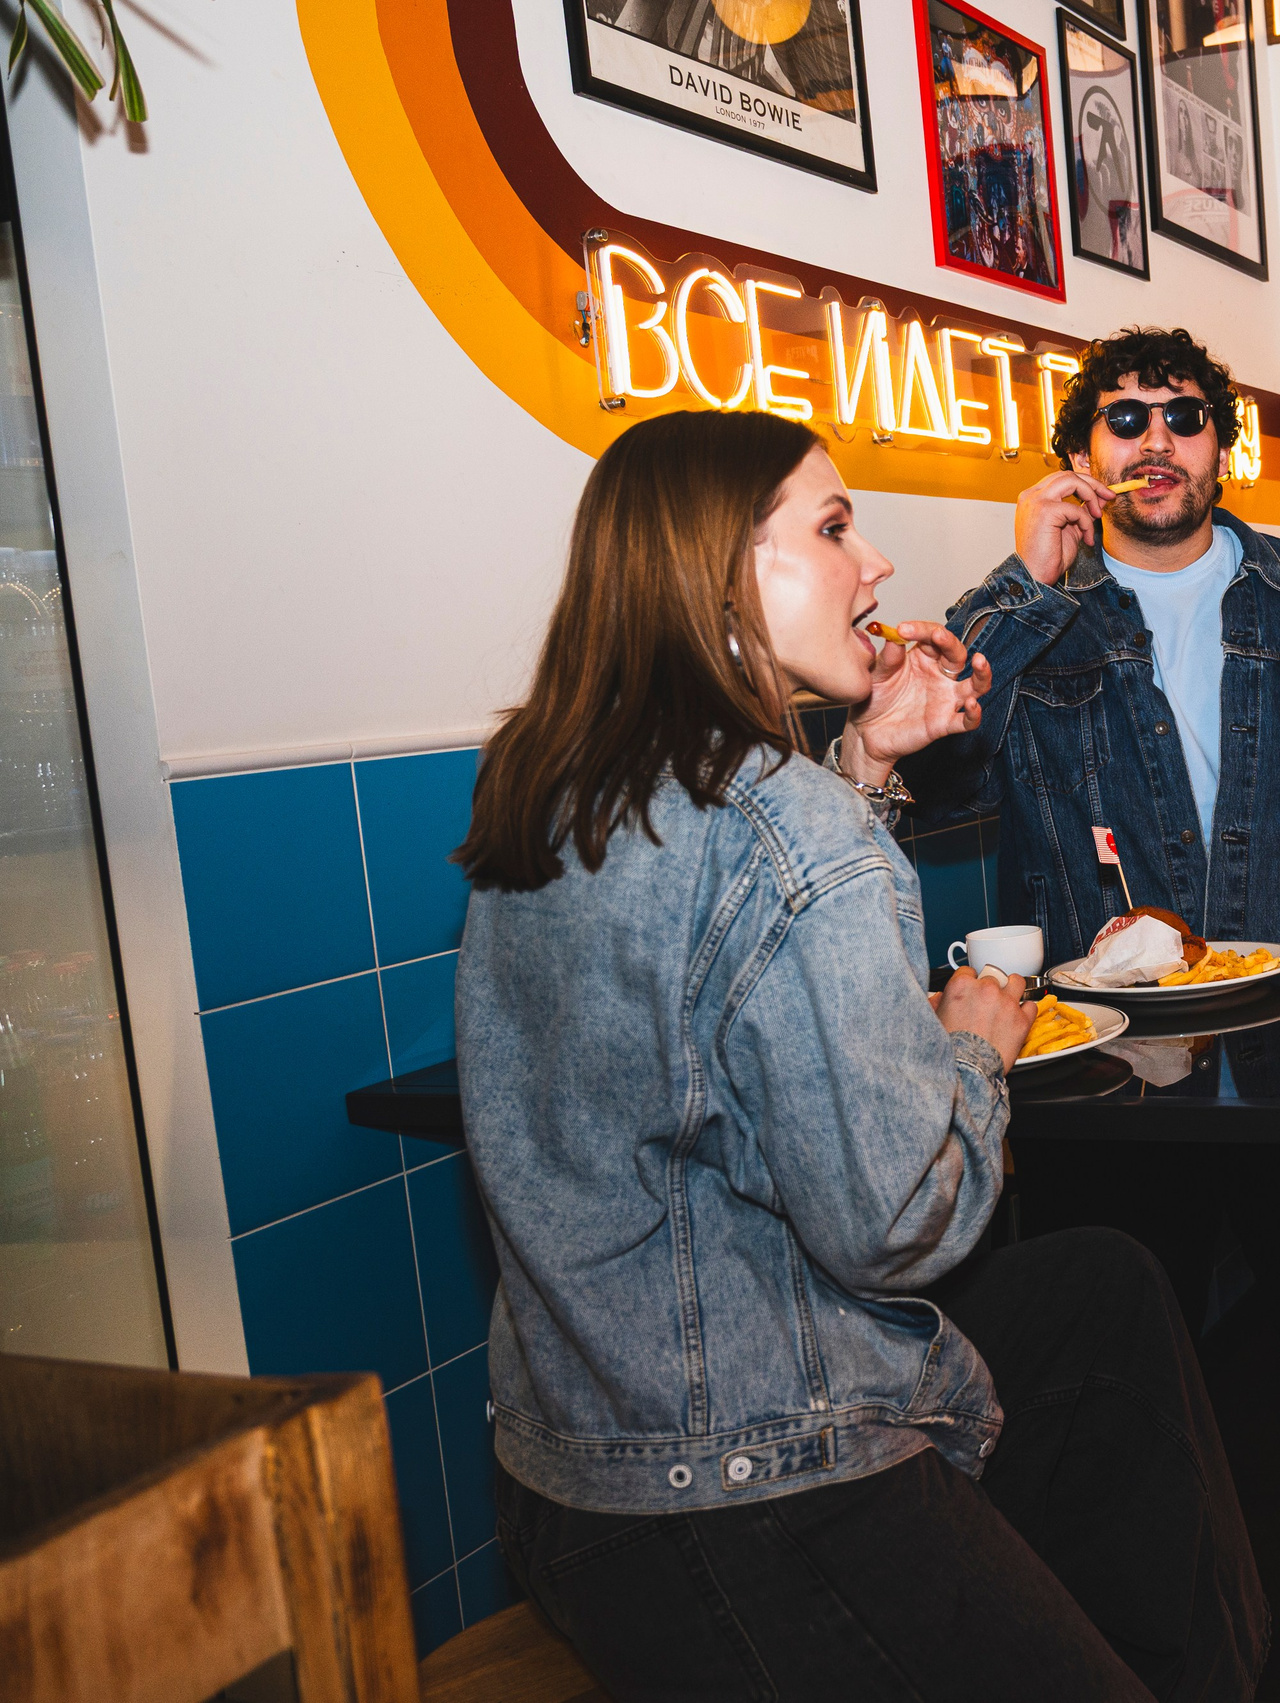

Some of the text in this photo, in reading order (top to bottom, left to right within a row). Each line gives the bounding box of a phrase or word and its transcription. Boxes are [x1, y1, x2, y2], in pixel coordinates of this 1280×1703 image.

[668, 64, 803, 132] DAVID BOWIE
[715, 106, 766, 130] LONDON 1977
[600, 244, 813, 420] ВСЕ
